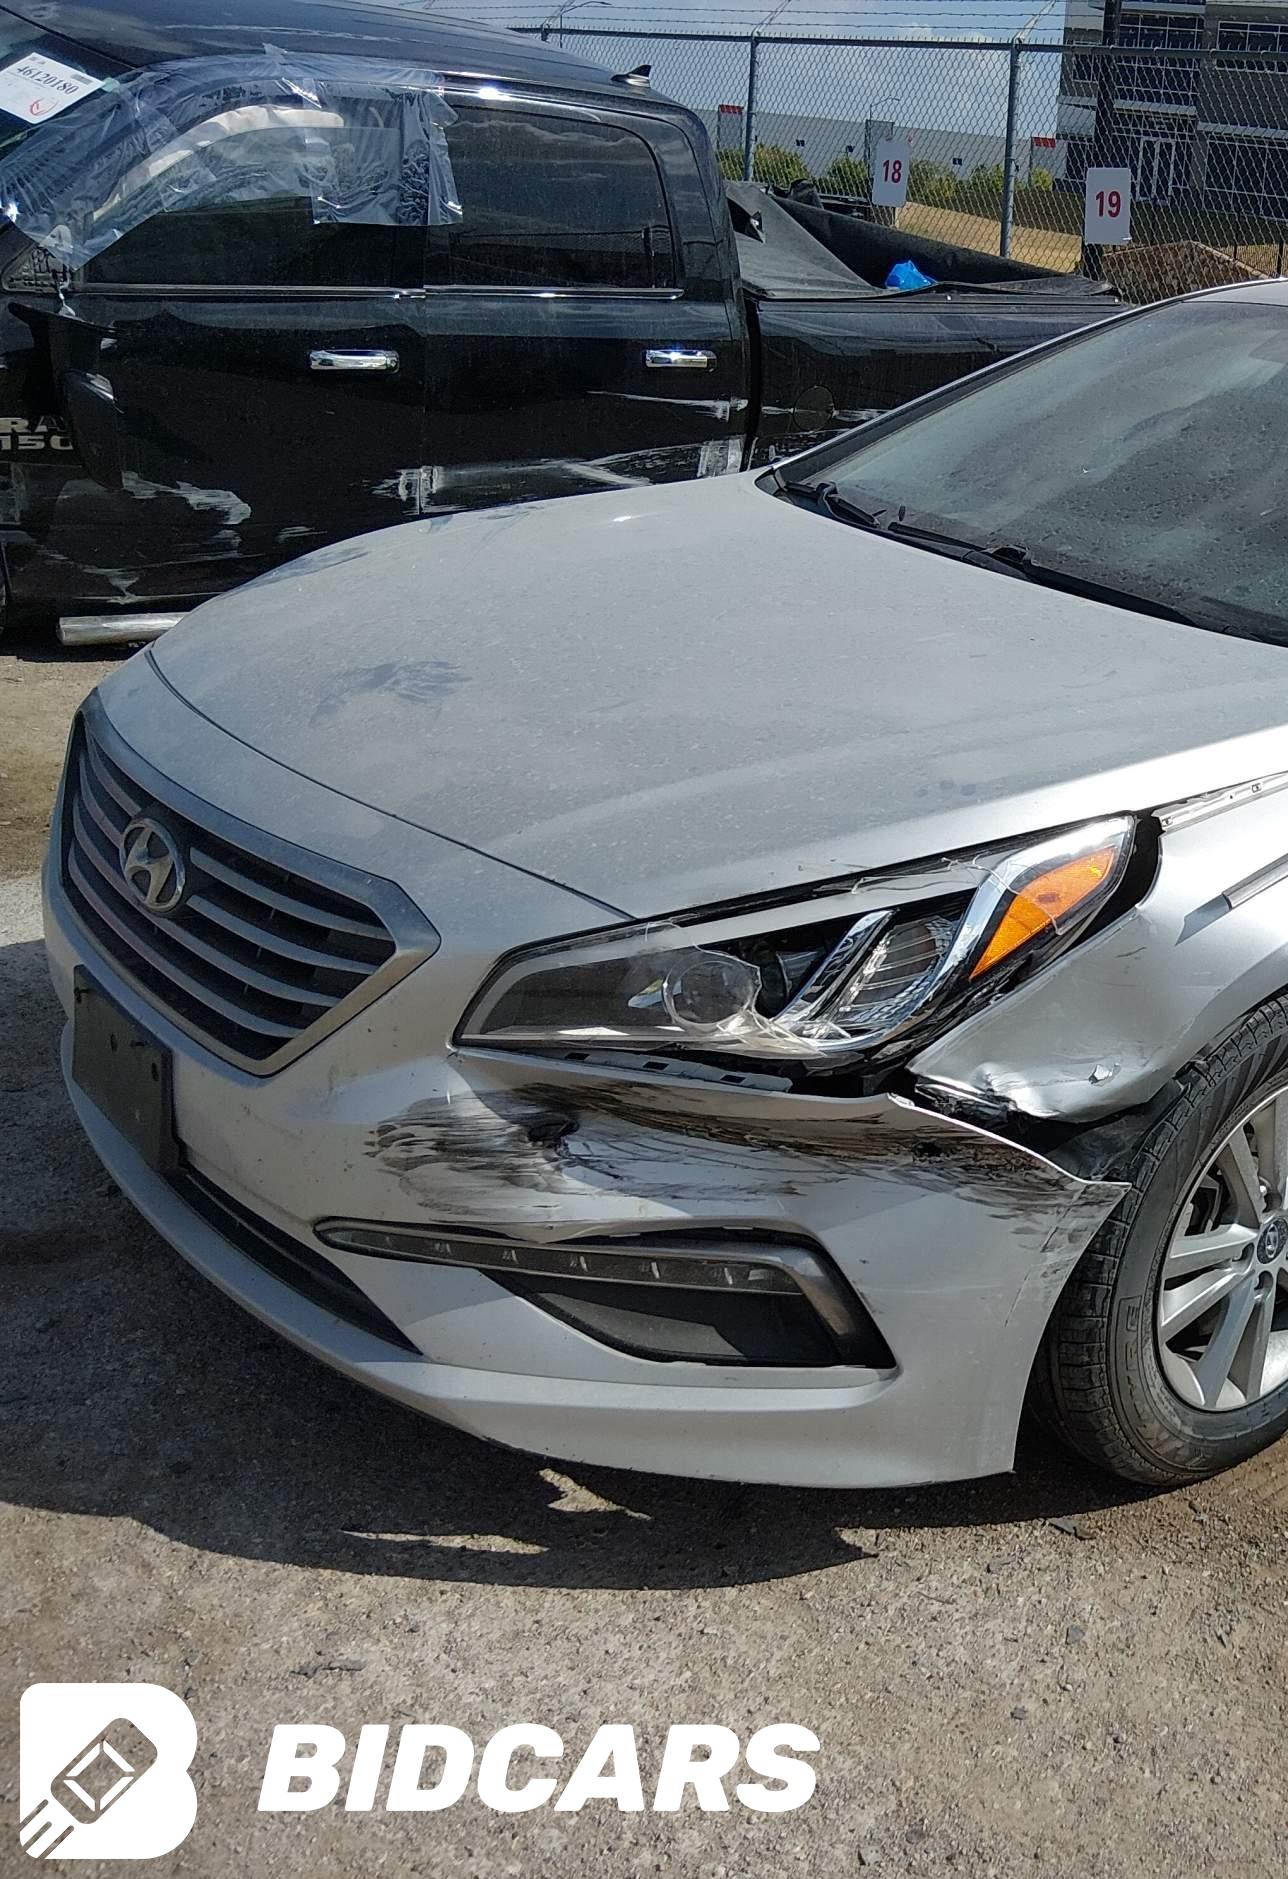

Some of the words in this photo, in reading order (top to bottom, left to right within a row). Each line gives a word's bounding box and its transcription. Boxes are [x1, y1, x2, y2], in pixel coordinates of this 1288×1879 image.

[17, 66, 80, 95] 46120180
[882, 159, 902, 183] 18
[1095, 191, 1121, 218] 19
[0, 416, 67, 433] RA
